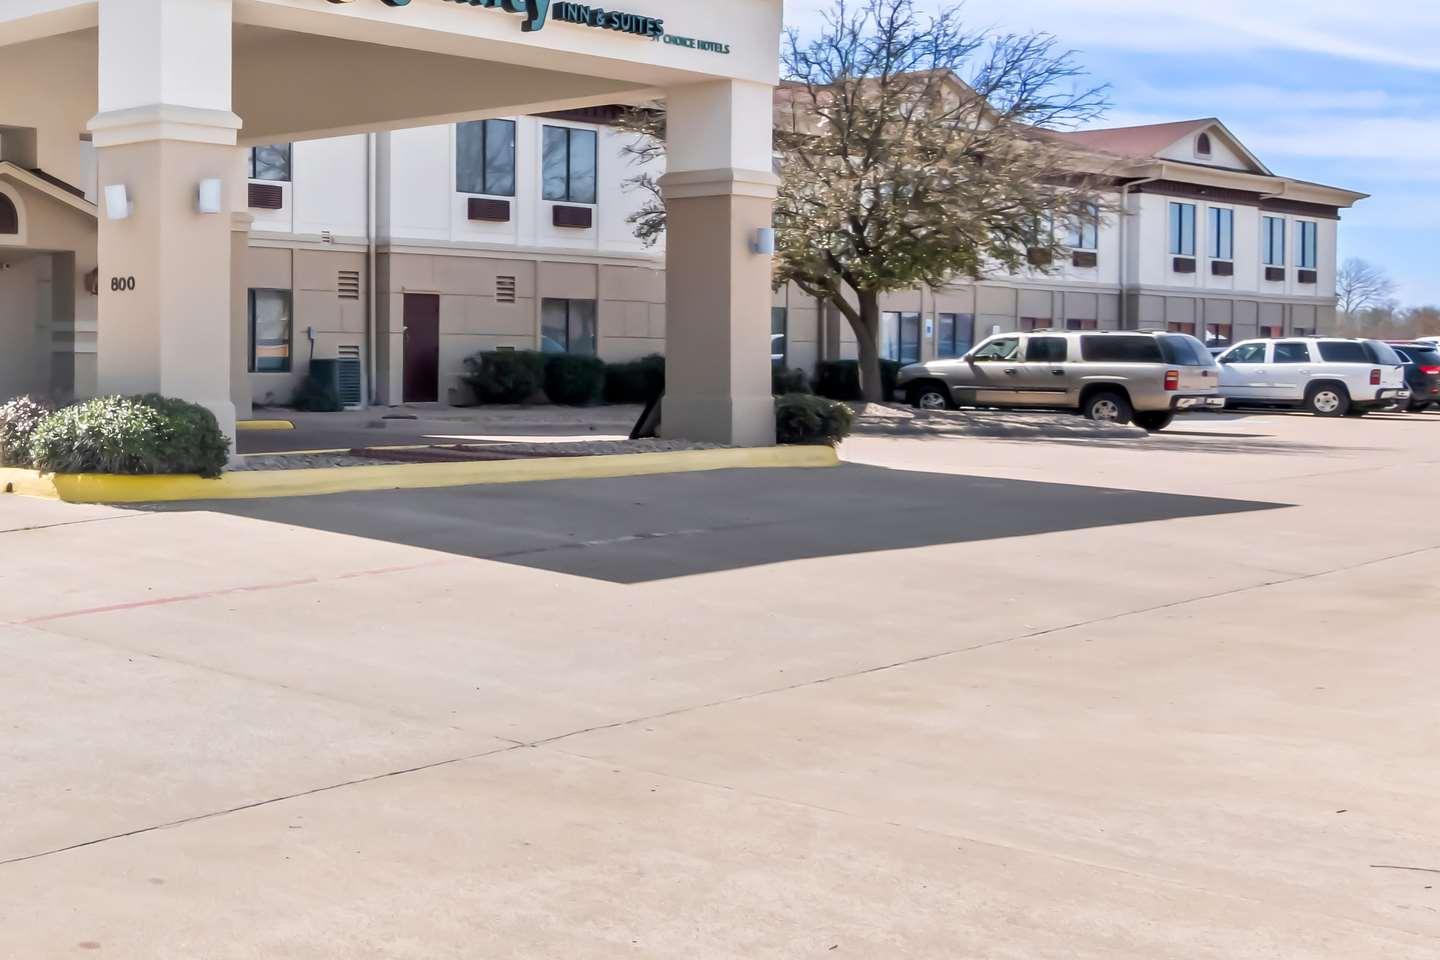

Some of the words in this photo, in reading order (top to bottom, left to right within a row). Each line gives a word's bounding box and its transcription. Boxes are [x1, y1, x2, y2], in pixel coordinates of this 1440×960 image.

[554, 1, 591, 26] INN
[594, 7, 607, 27] &
[610, 10, 664, 38] SUITES
[696, 39, 730, 54] HOTELS
[111, 276, 135, 291] 800
